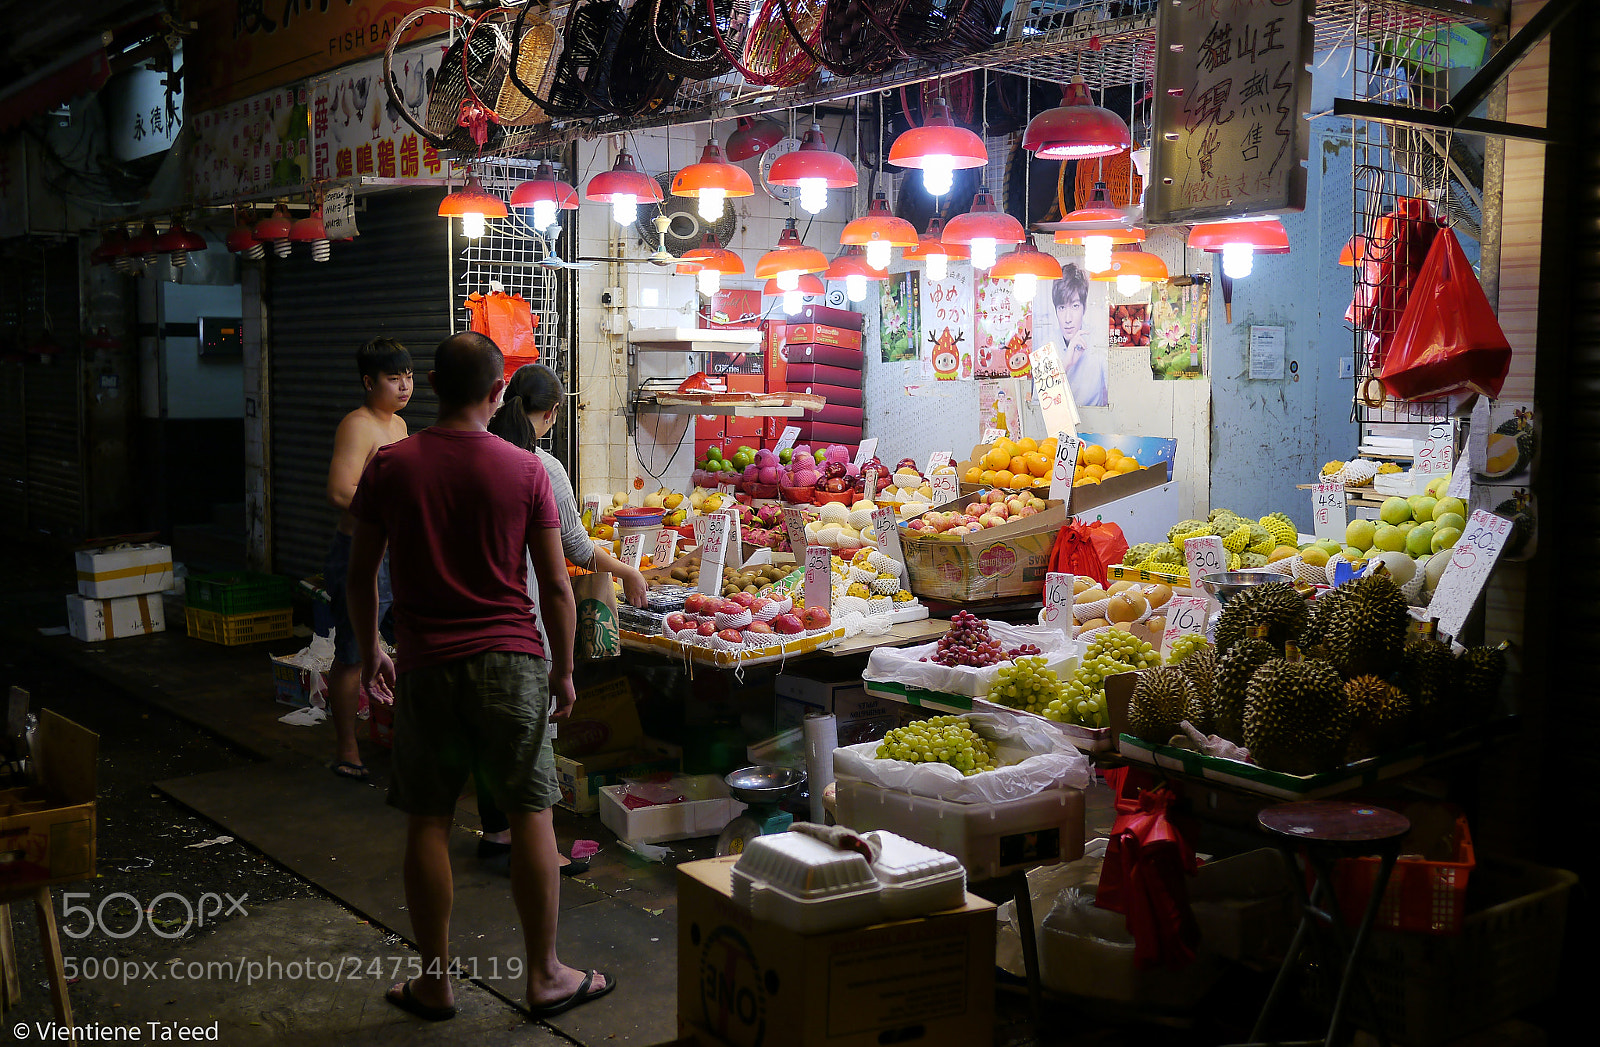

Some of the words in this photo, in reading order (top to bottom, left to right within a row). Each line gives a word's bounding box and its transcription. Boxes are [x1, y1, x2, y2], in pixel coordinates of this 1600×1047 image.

[329, 27, 365, 57] FISH
[1196, 18, 1285, 74] 貓山王
[930, 284, 958, 308] ゆめ
[1318, 493, 1343, 509] 48元
[1172, 608, 1202, 633] 16元
